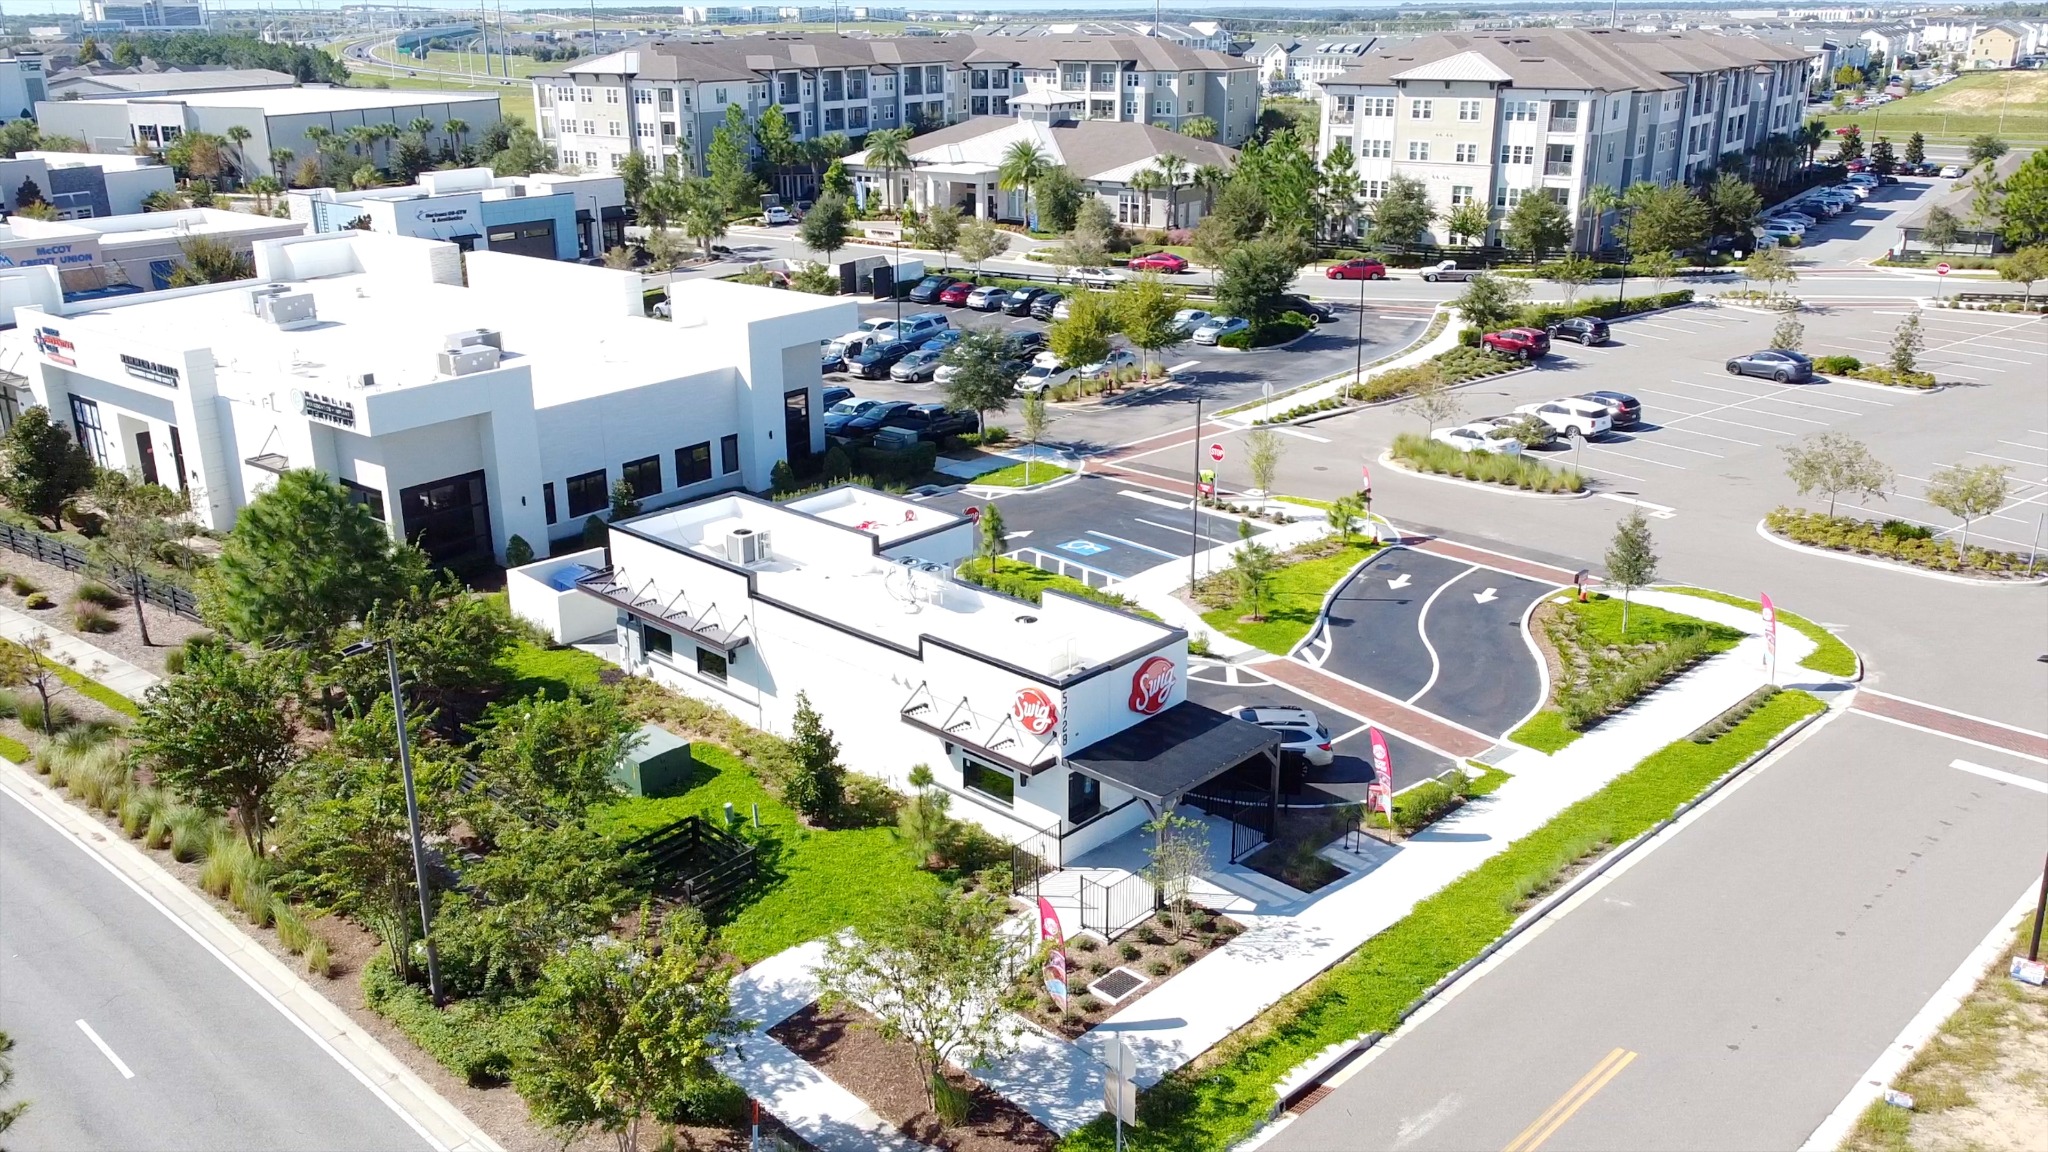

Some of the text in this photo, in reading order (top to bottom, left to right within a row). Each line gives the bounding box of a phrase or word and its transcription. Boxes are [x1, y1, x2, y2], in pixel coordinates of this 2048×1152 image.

[36, 244, 72, 255] McCOY
[20, 254, 93, 267] CREDIT UNION
[307, 409, 354, 427] DENTISTRY
[1210, 447, 1224, 456] STOP
[1135, 665, 1176, 711] Swig
[1012, 691, 1052, 731] Swig
[1061, 691, 1069, 746] 5728
